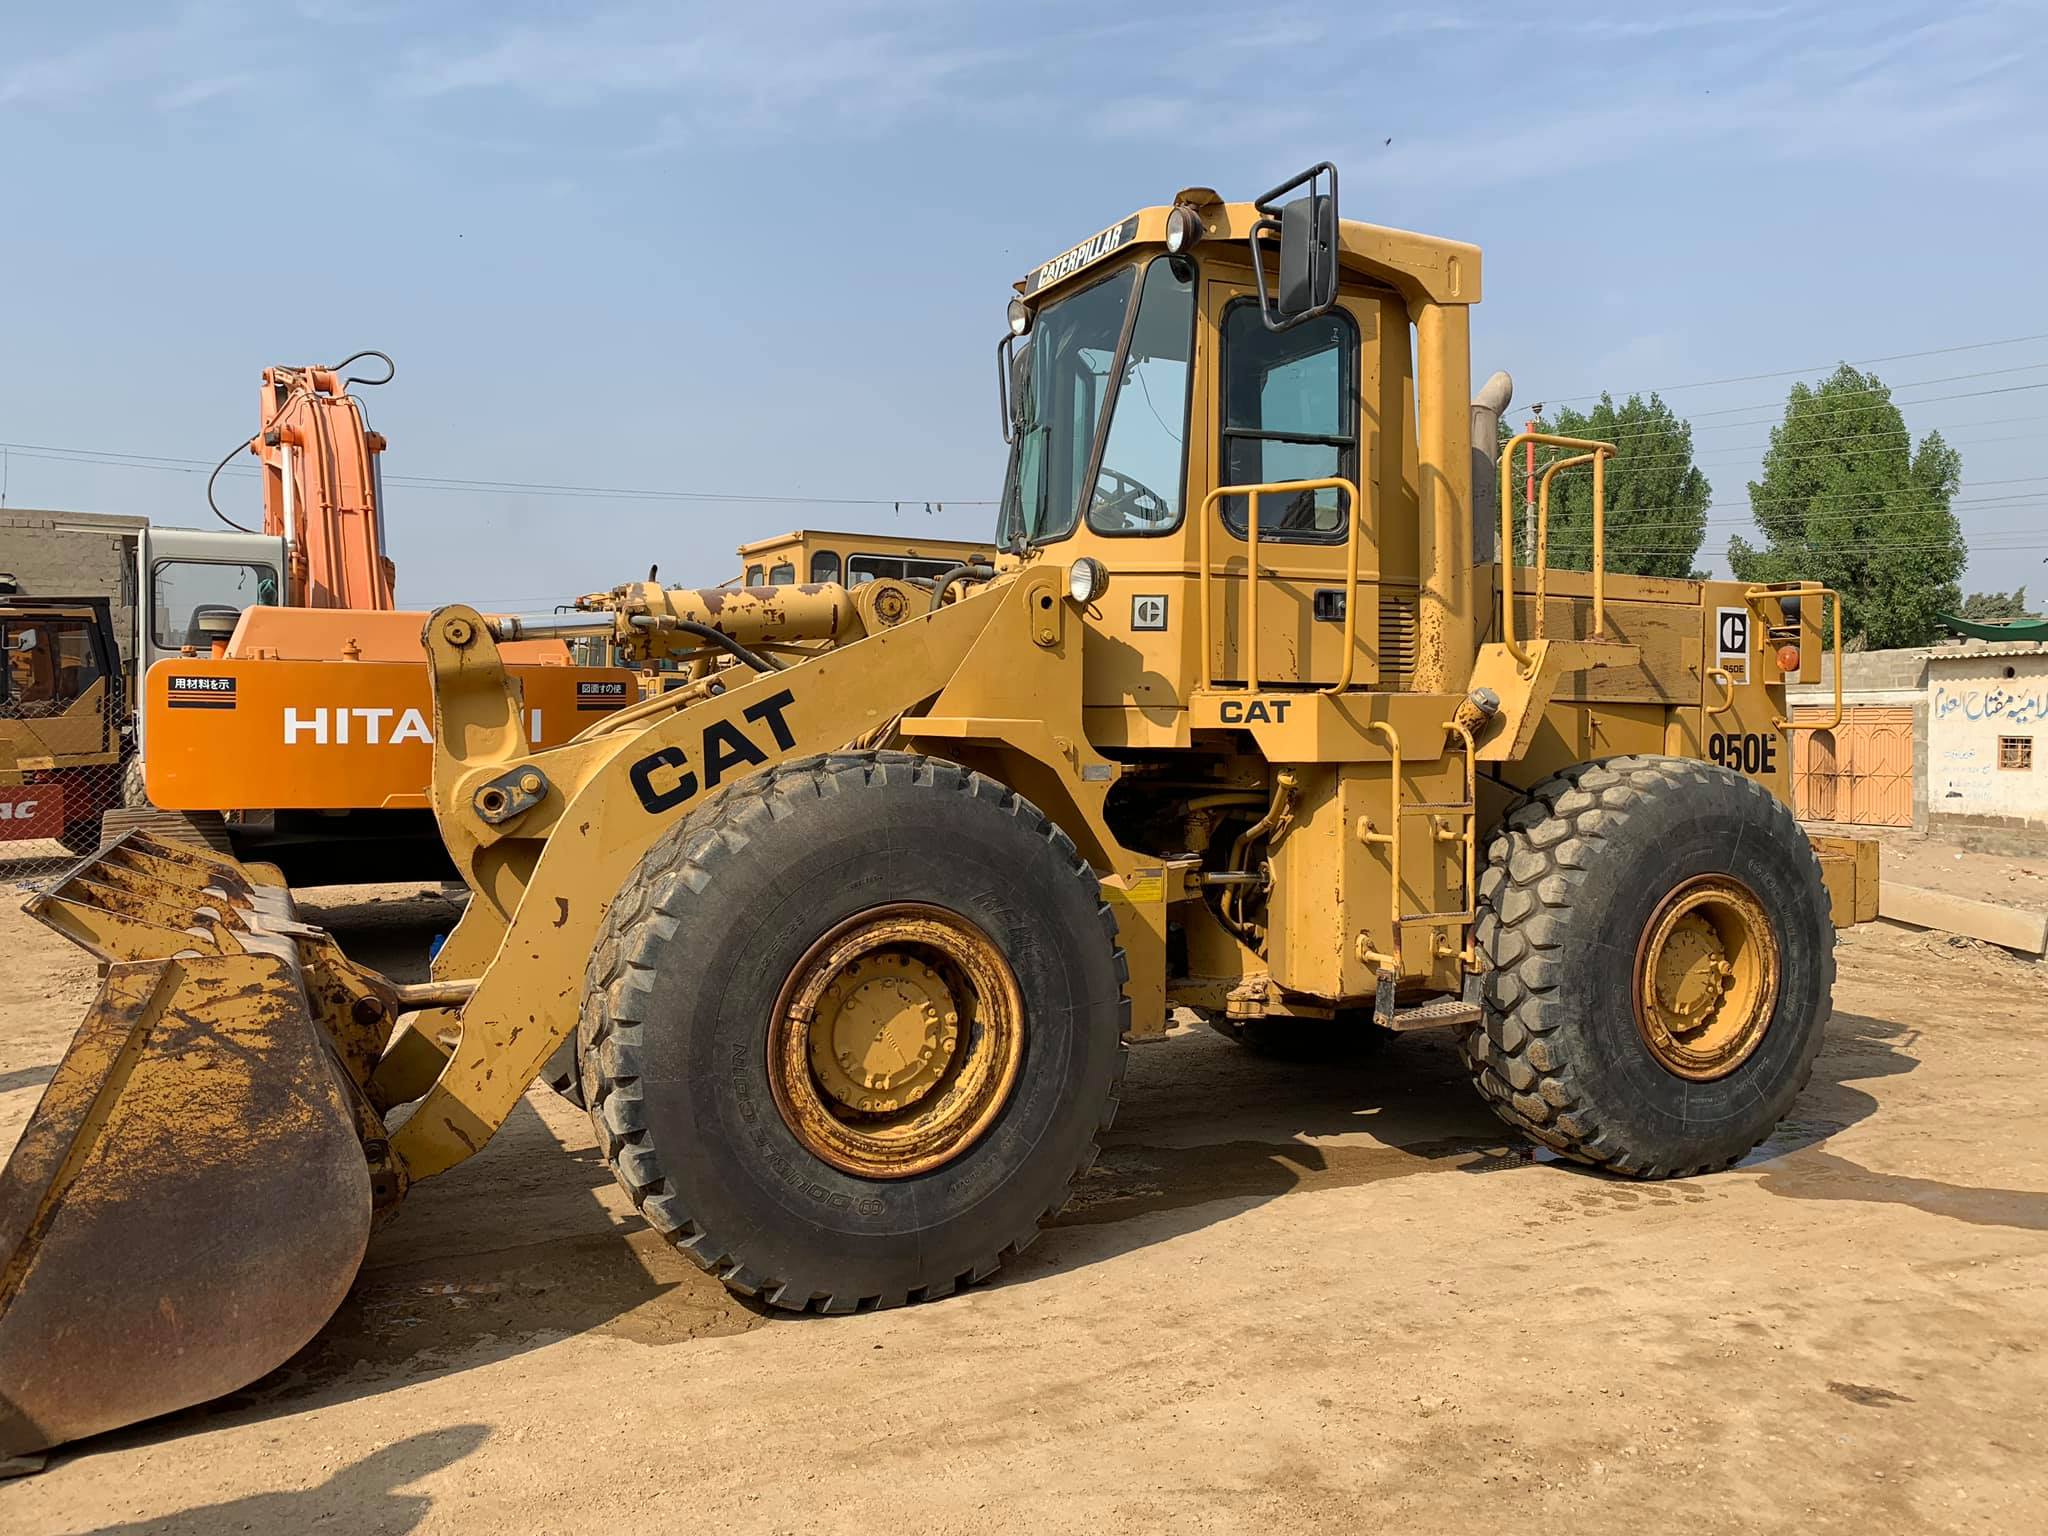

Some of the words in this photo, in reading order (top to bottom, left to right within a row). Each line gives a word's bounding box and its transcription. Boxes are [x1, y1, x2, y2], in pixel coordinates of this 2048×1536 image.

[1038, 224, 1122, 289] CATERPILLAR
[284, 707, 542, 744] HITAI
[1220, 700, 1291, 723] CAT
[630, 688, 797, 815] CAT
[1709, 733, 1777, 774] 950E
